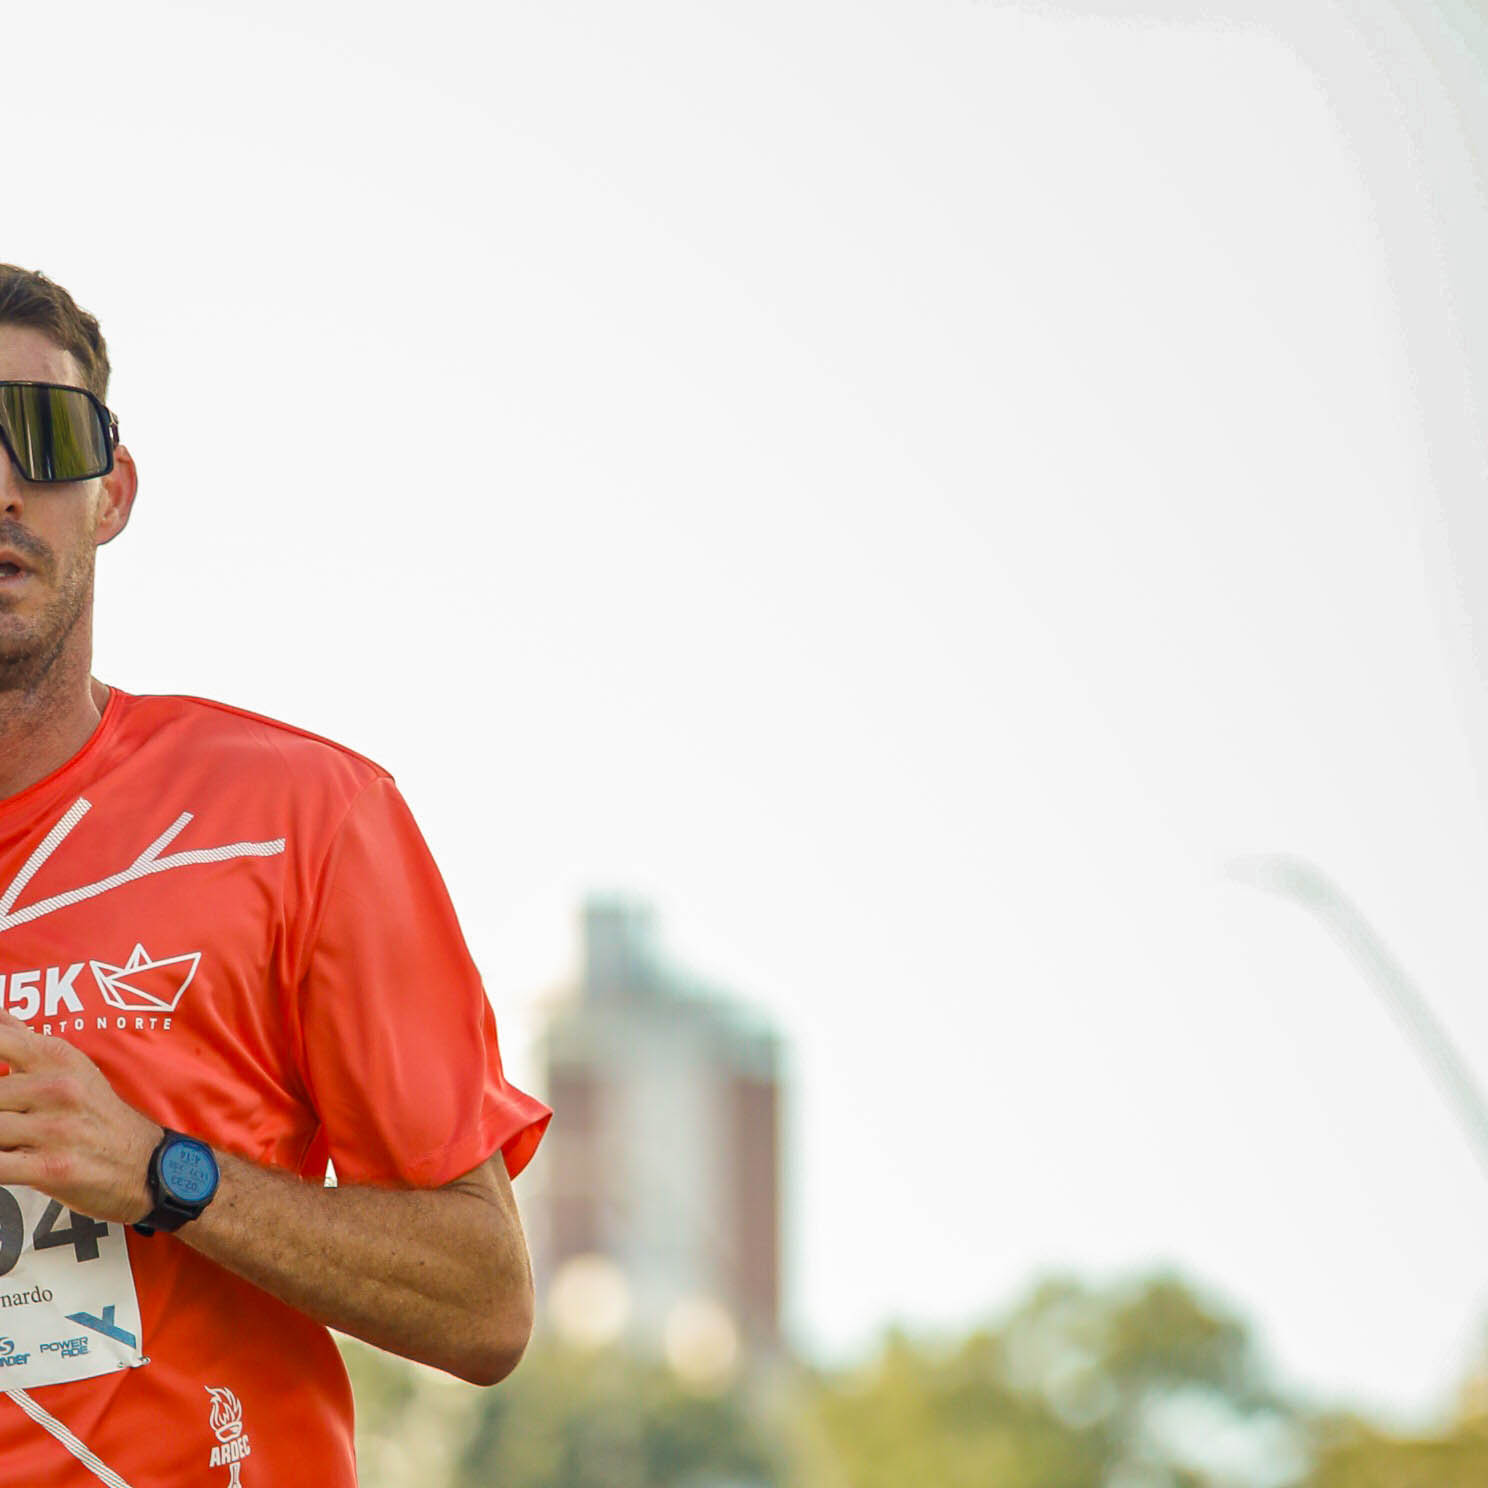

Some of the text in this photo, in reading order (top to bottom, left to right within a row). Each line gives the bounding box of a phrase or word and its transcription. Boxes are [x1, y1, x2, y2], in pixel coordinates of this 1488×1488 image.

[27, 1016, 172, 1037] RTO NORTE
[39, 1336, 89, 1353] POWER
[209, 1434, 251, 1468] ARDEC
